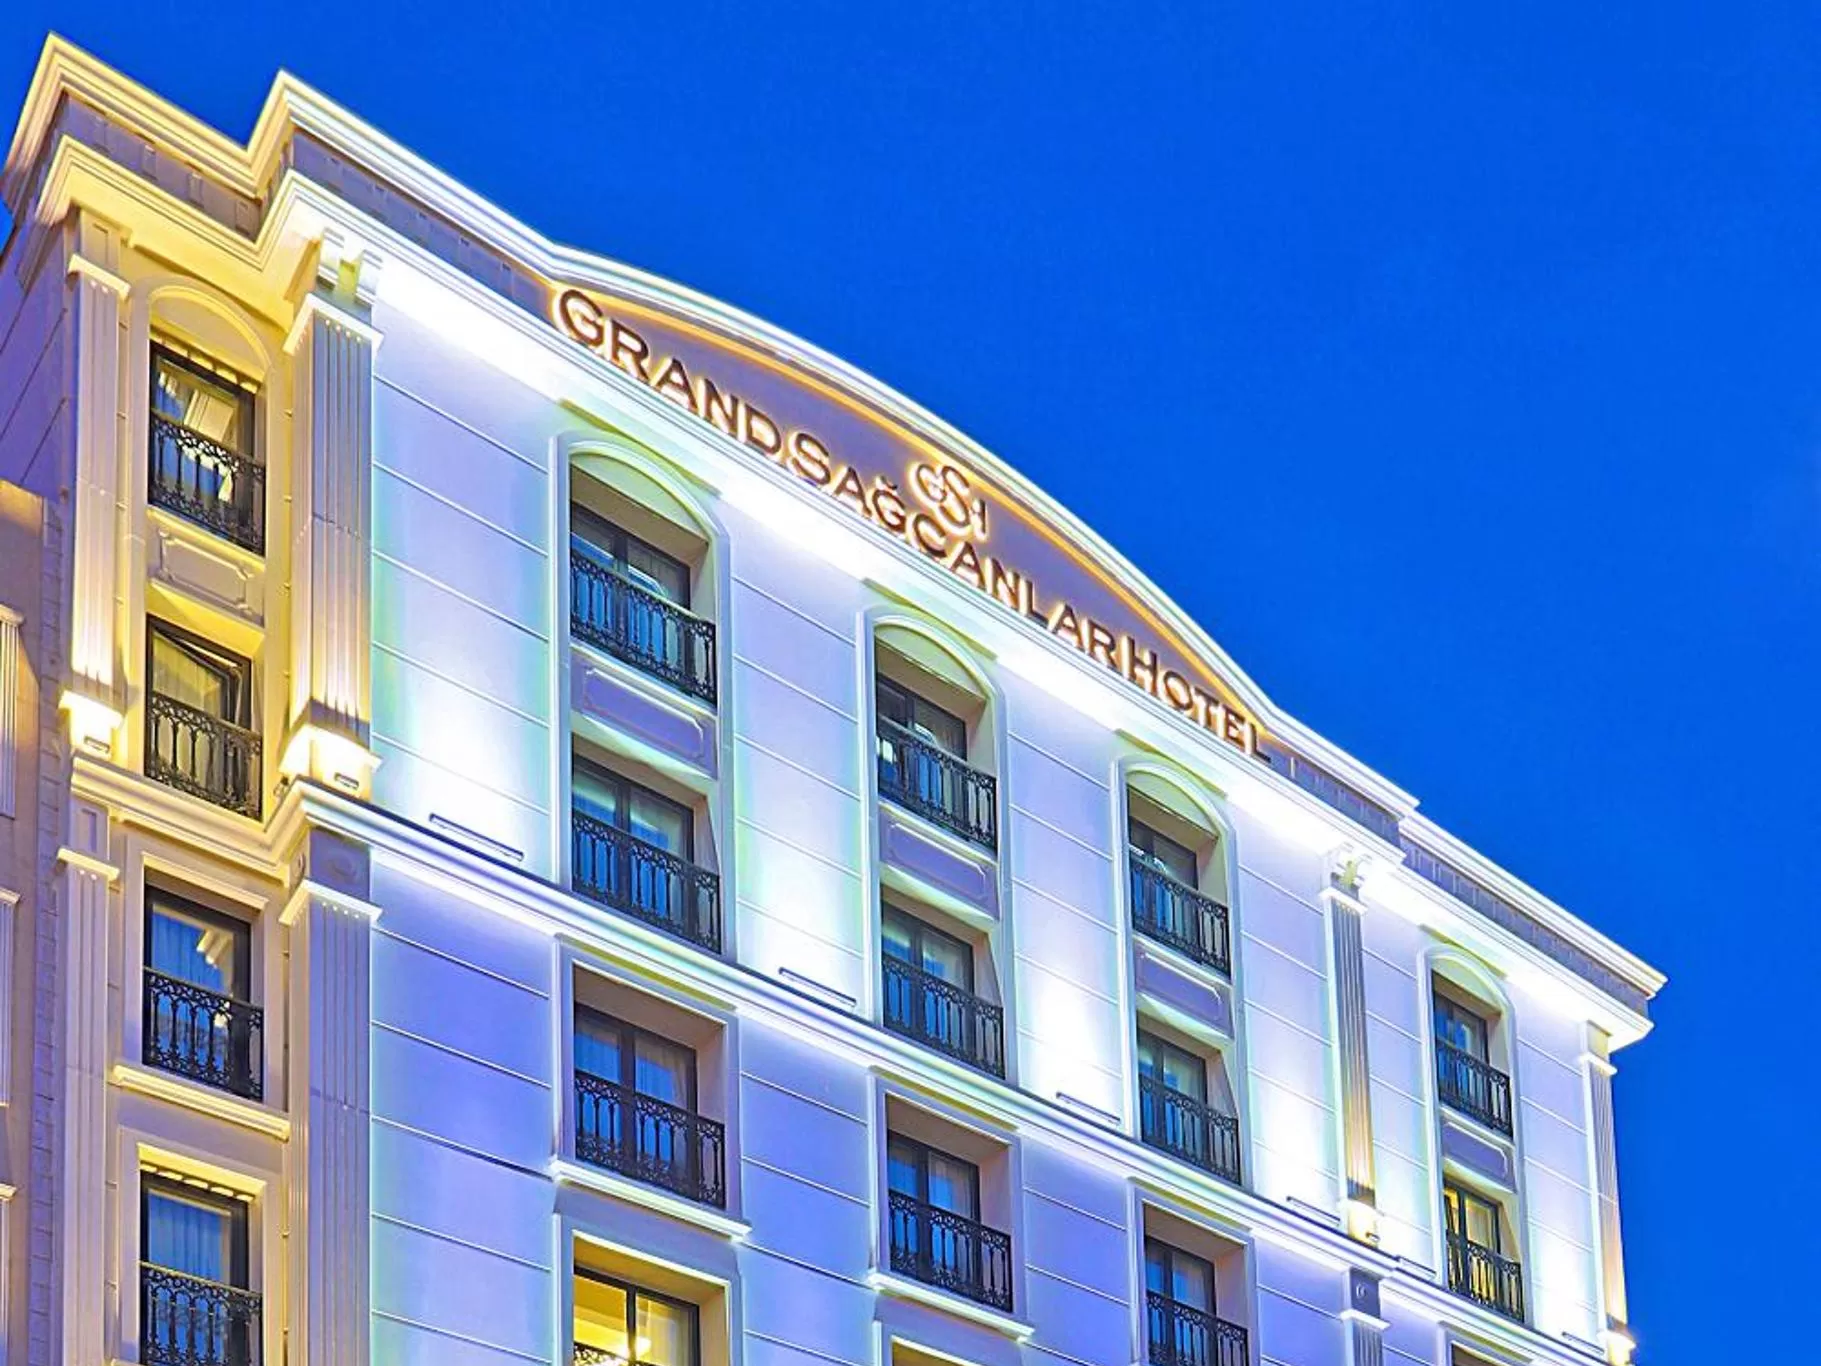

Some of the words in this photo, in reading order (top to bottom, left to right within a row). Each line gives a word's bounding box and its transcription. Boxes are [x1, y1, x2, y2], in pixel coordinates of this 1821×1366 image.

[556, 288, 783, 457] GRAND
[787, 431, 1120, 670] SAĞCANLAR
[1121, 634, 1272, 763] HOTEL
